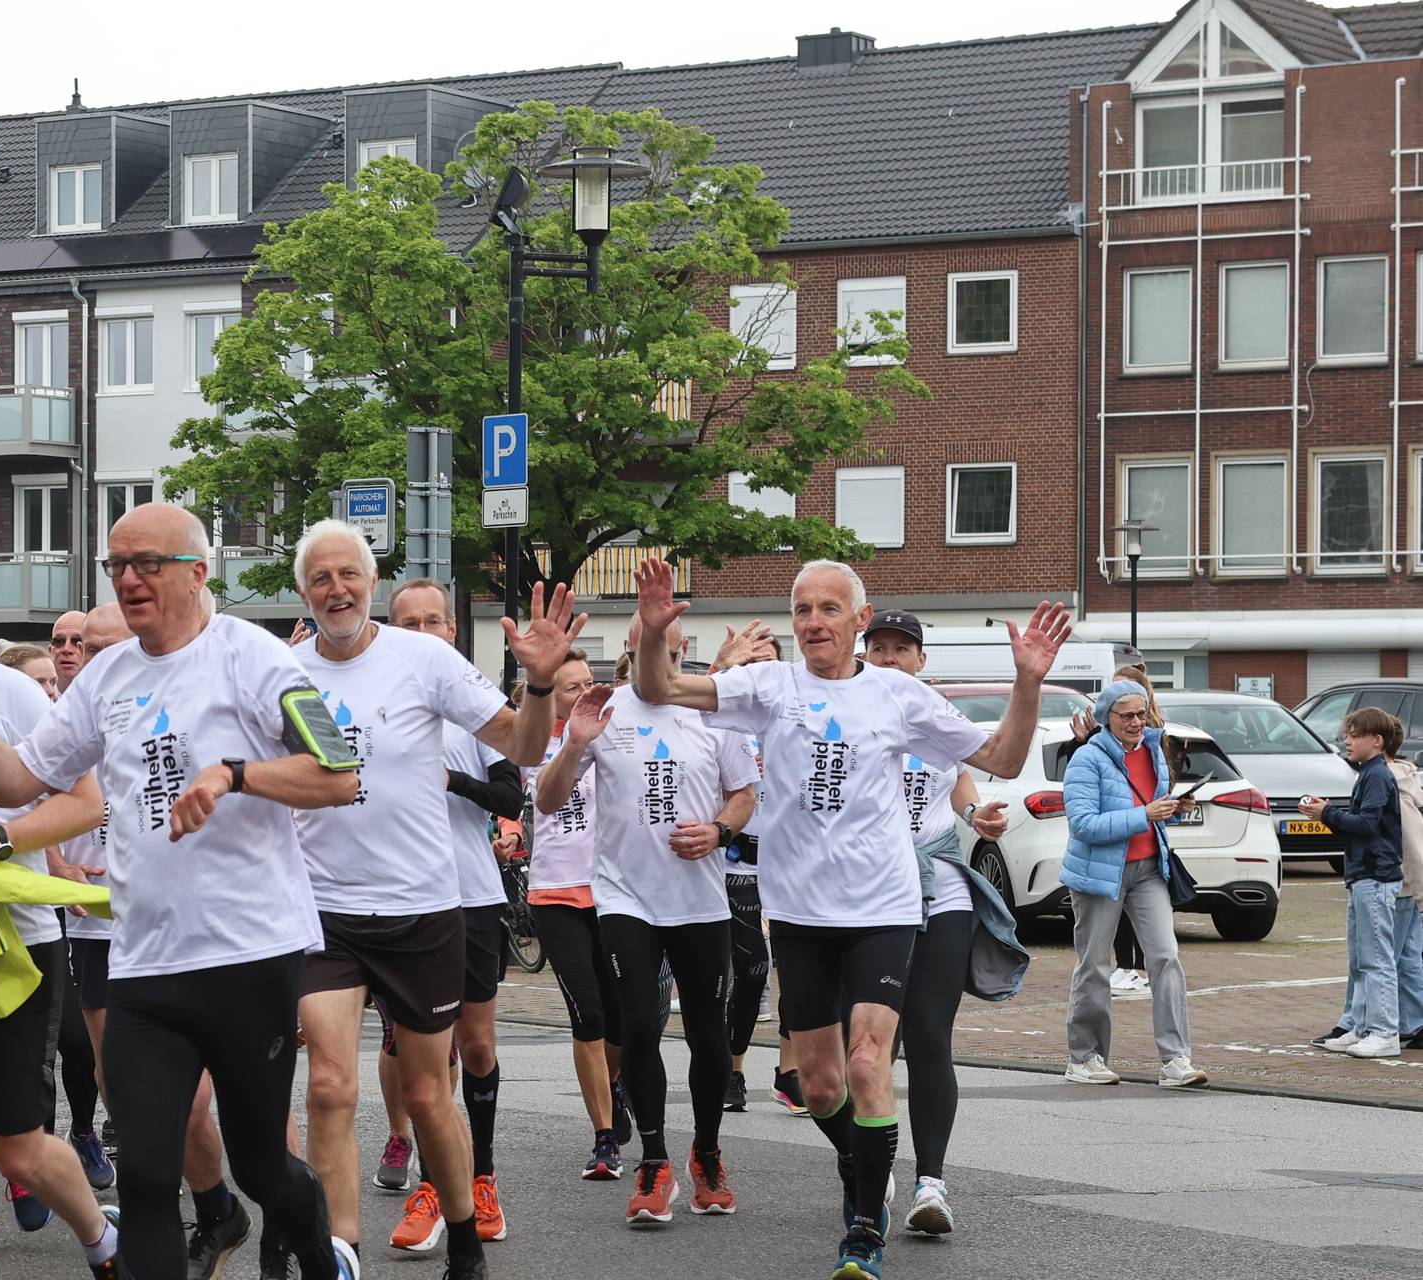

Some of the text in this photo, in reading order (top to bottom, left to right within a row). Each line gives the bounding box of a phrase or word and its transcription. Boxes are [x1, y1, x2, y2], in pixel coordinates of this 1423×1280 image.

[493, 425, 517, 478] P
[350, 492, 386, 501] PARKSCHEIN-
[354, 504, 381, 513] AUTOMAT
[501, 499, 509, 508] mit
[361, 517, 387, 525] Parkschein
[492, 510, 517, 520] Parkschein
[179, 732, 192, 768] für die
[364, 726, 376, 757] für die
[849, 744, 859, 771] für die
[141, 738, 167, 831] vrijheid
[160, 732, 185, 813] freihe
[678, 760, 687, 786] für die
[808, 741, 829, 812] vrijheid
[827, 741, 849, 813] freiheit
[644, 761, 663, 826] vrijheid
[662, 759, 678, 824] freiheit
[910, 770, 930, 833] freiheit
[611, 953, 621, 978] FUSION
